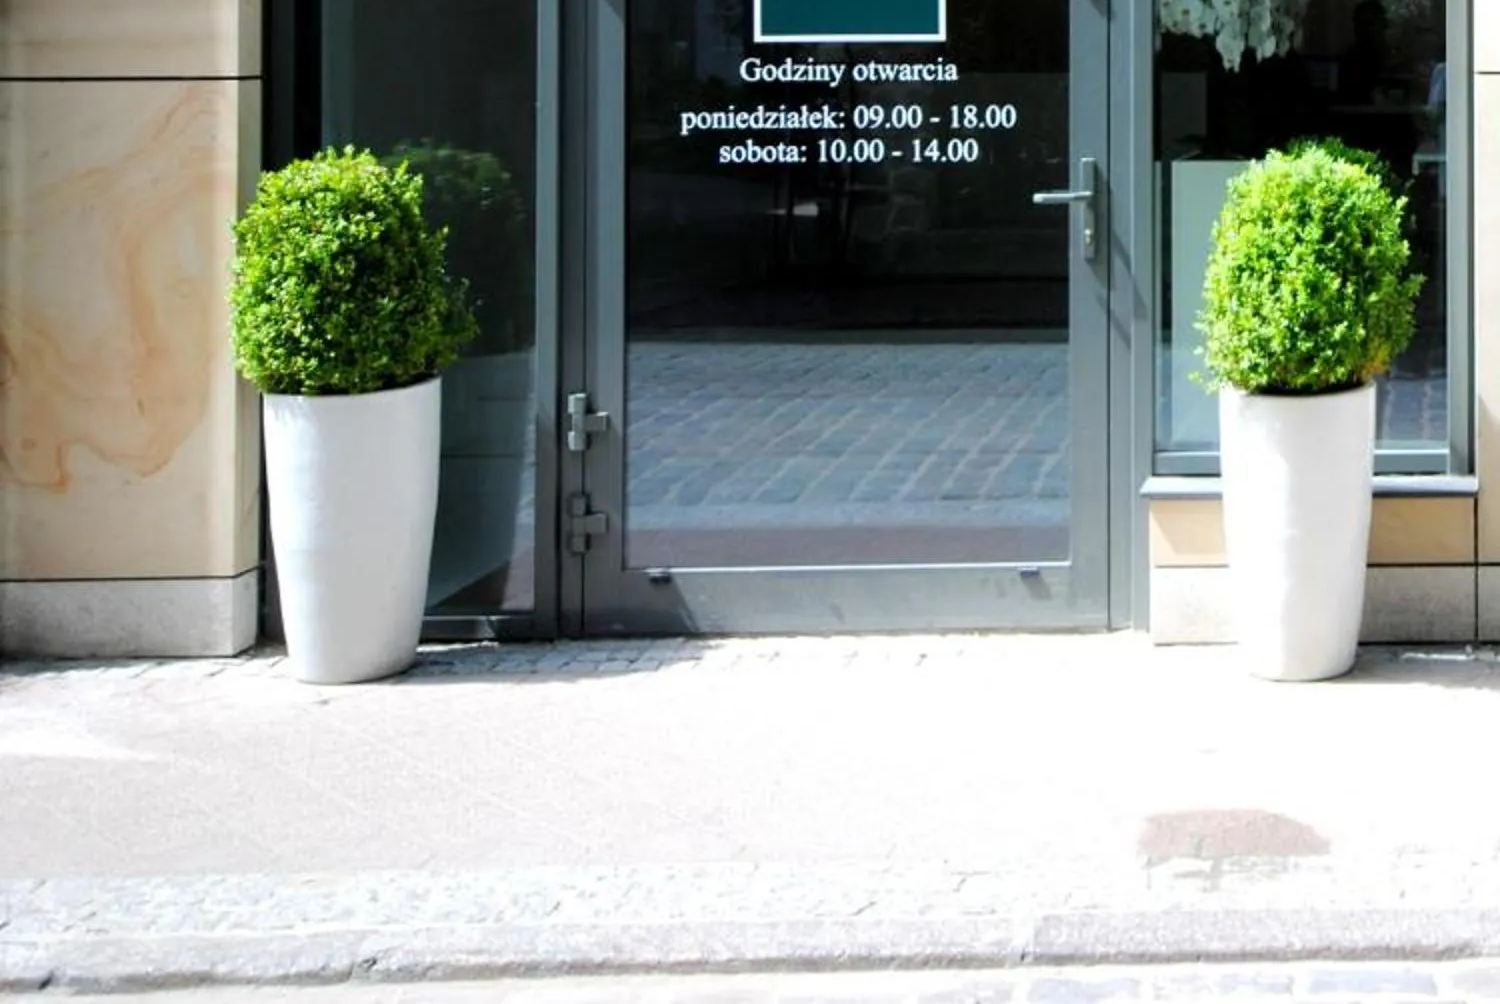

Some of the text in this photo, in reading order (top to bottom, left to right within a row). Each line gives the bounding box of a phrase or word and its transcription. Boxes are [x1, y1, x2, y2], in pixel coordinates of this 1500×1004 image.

[739, 57, 959, 88] Godziny otwarcia
[680, 104, 845, 136] poniedziałek:
[853, 104, 923, 129] 09.00
[950, 104, 1017, 129] 18.00
[719, 138, 807, 163] sobota:
[818, 138, 885, 163] 10.00
[912, 137, 979, 163] 14.00
